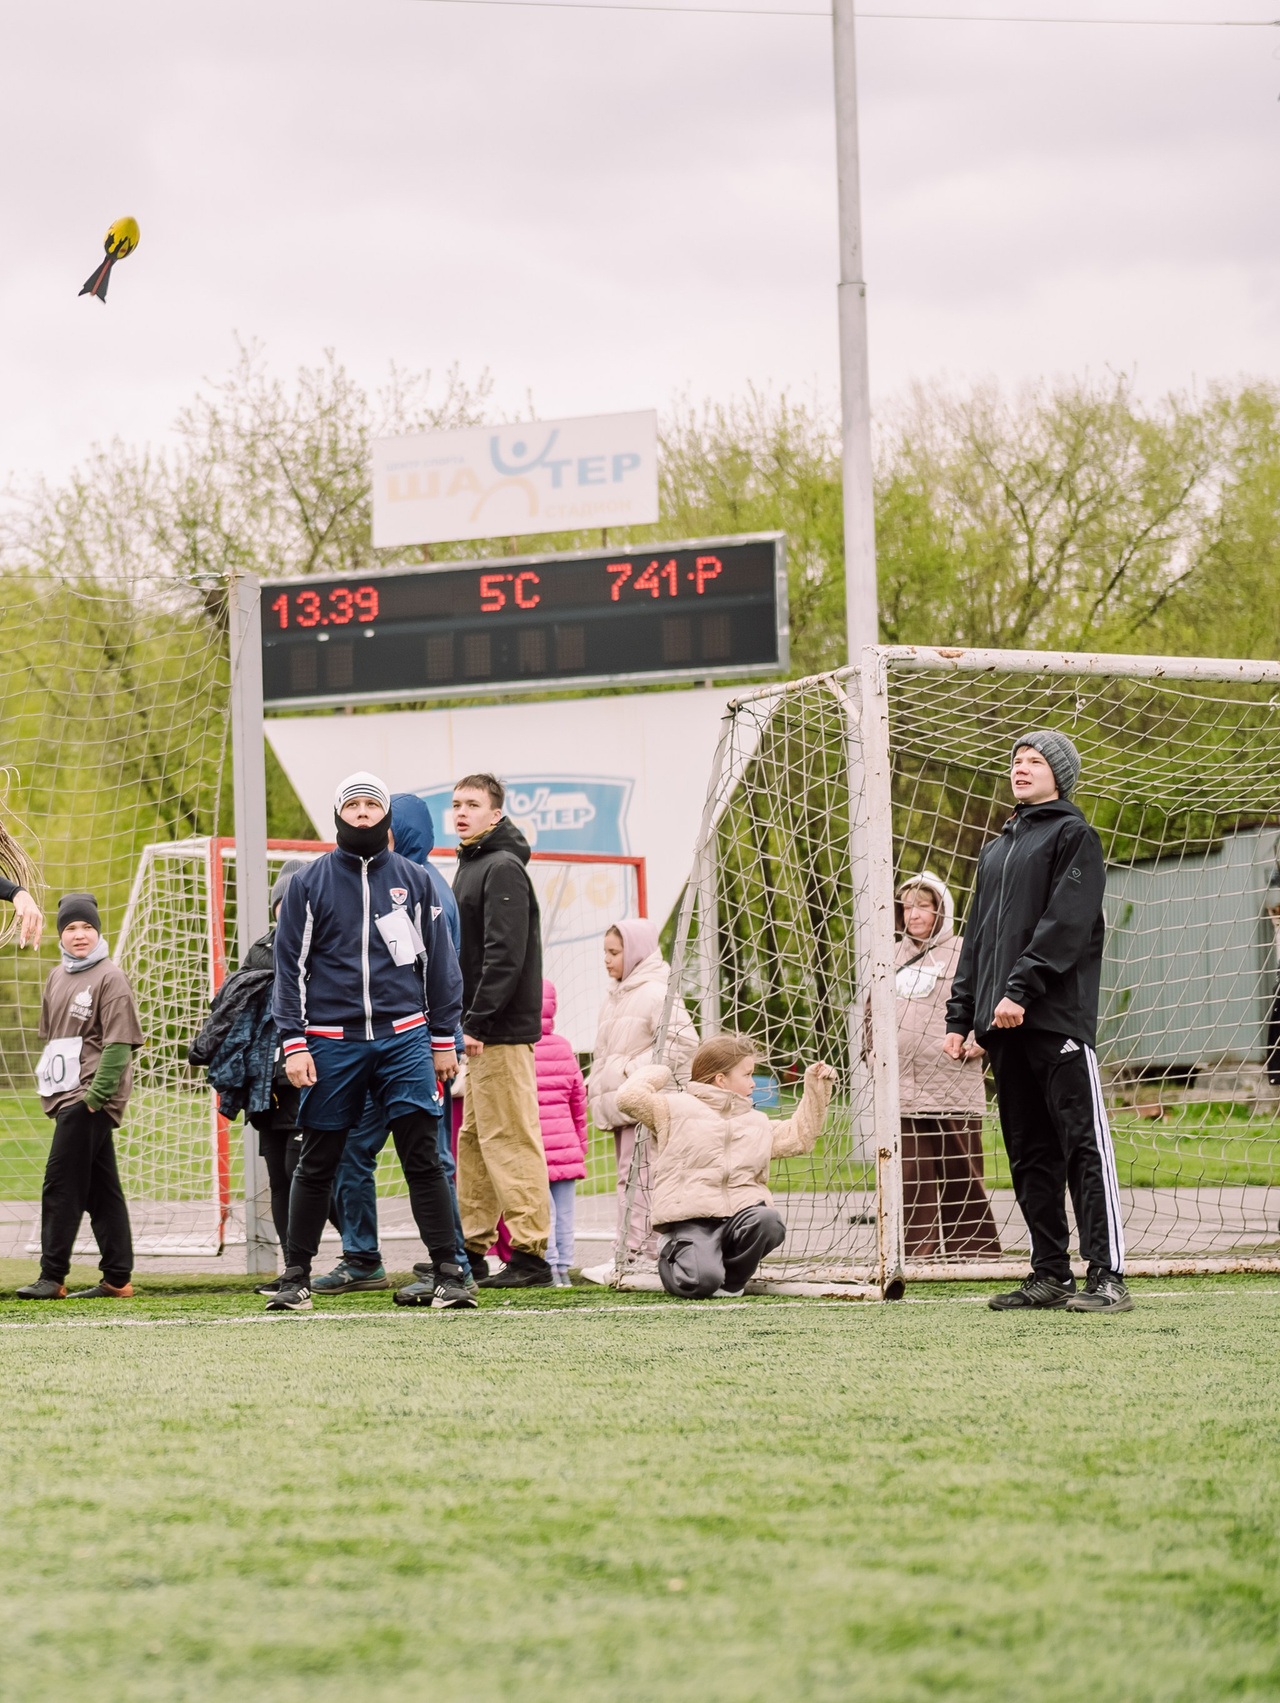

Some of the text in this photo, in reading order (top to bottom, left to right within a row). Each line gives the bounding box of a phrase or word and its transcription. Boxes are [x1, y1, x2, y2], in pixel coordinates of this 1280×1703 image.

[545, 498, 632, 519] СТАДИОН
[272, 585, 379, 628] 13.39
[389, 939, 397, 956] 7
[43, 1053, 66, 1088] 40
